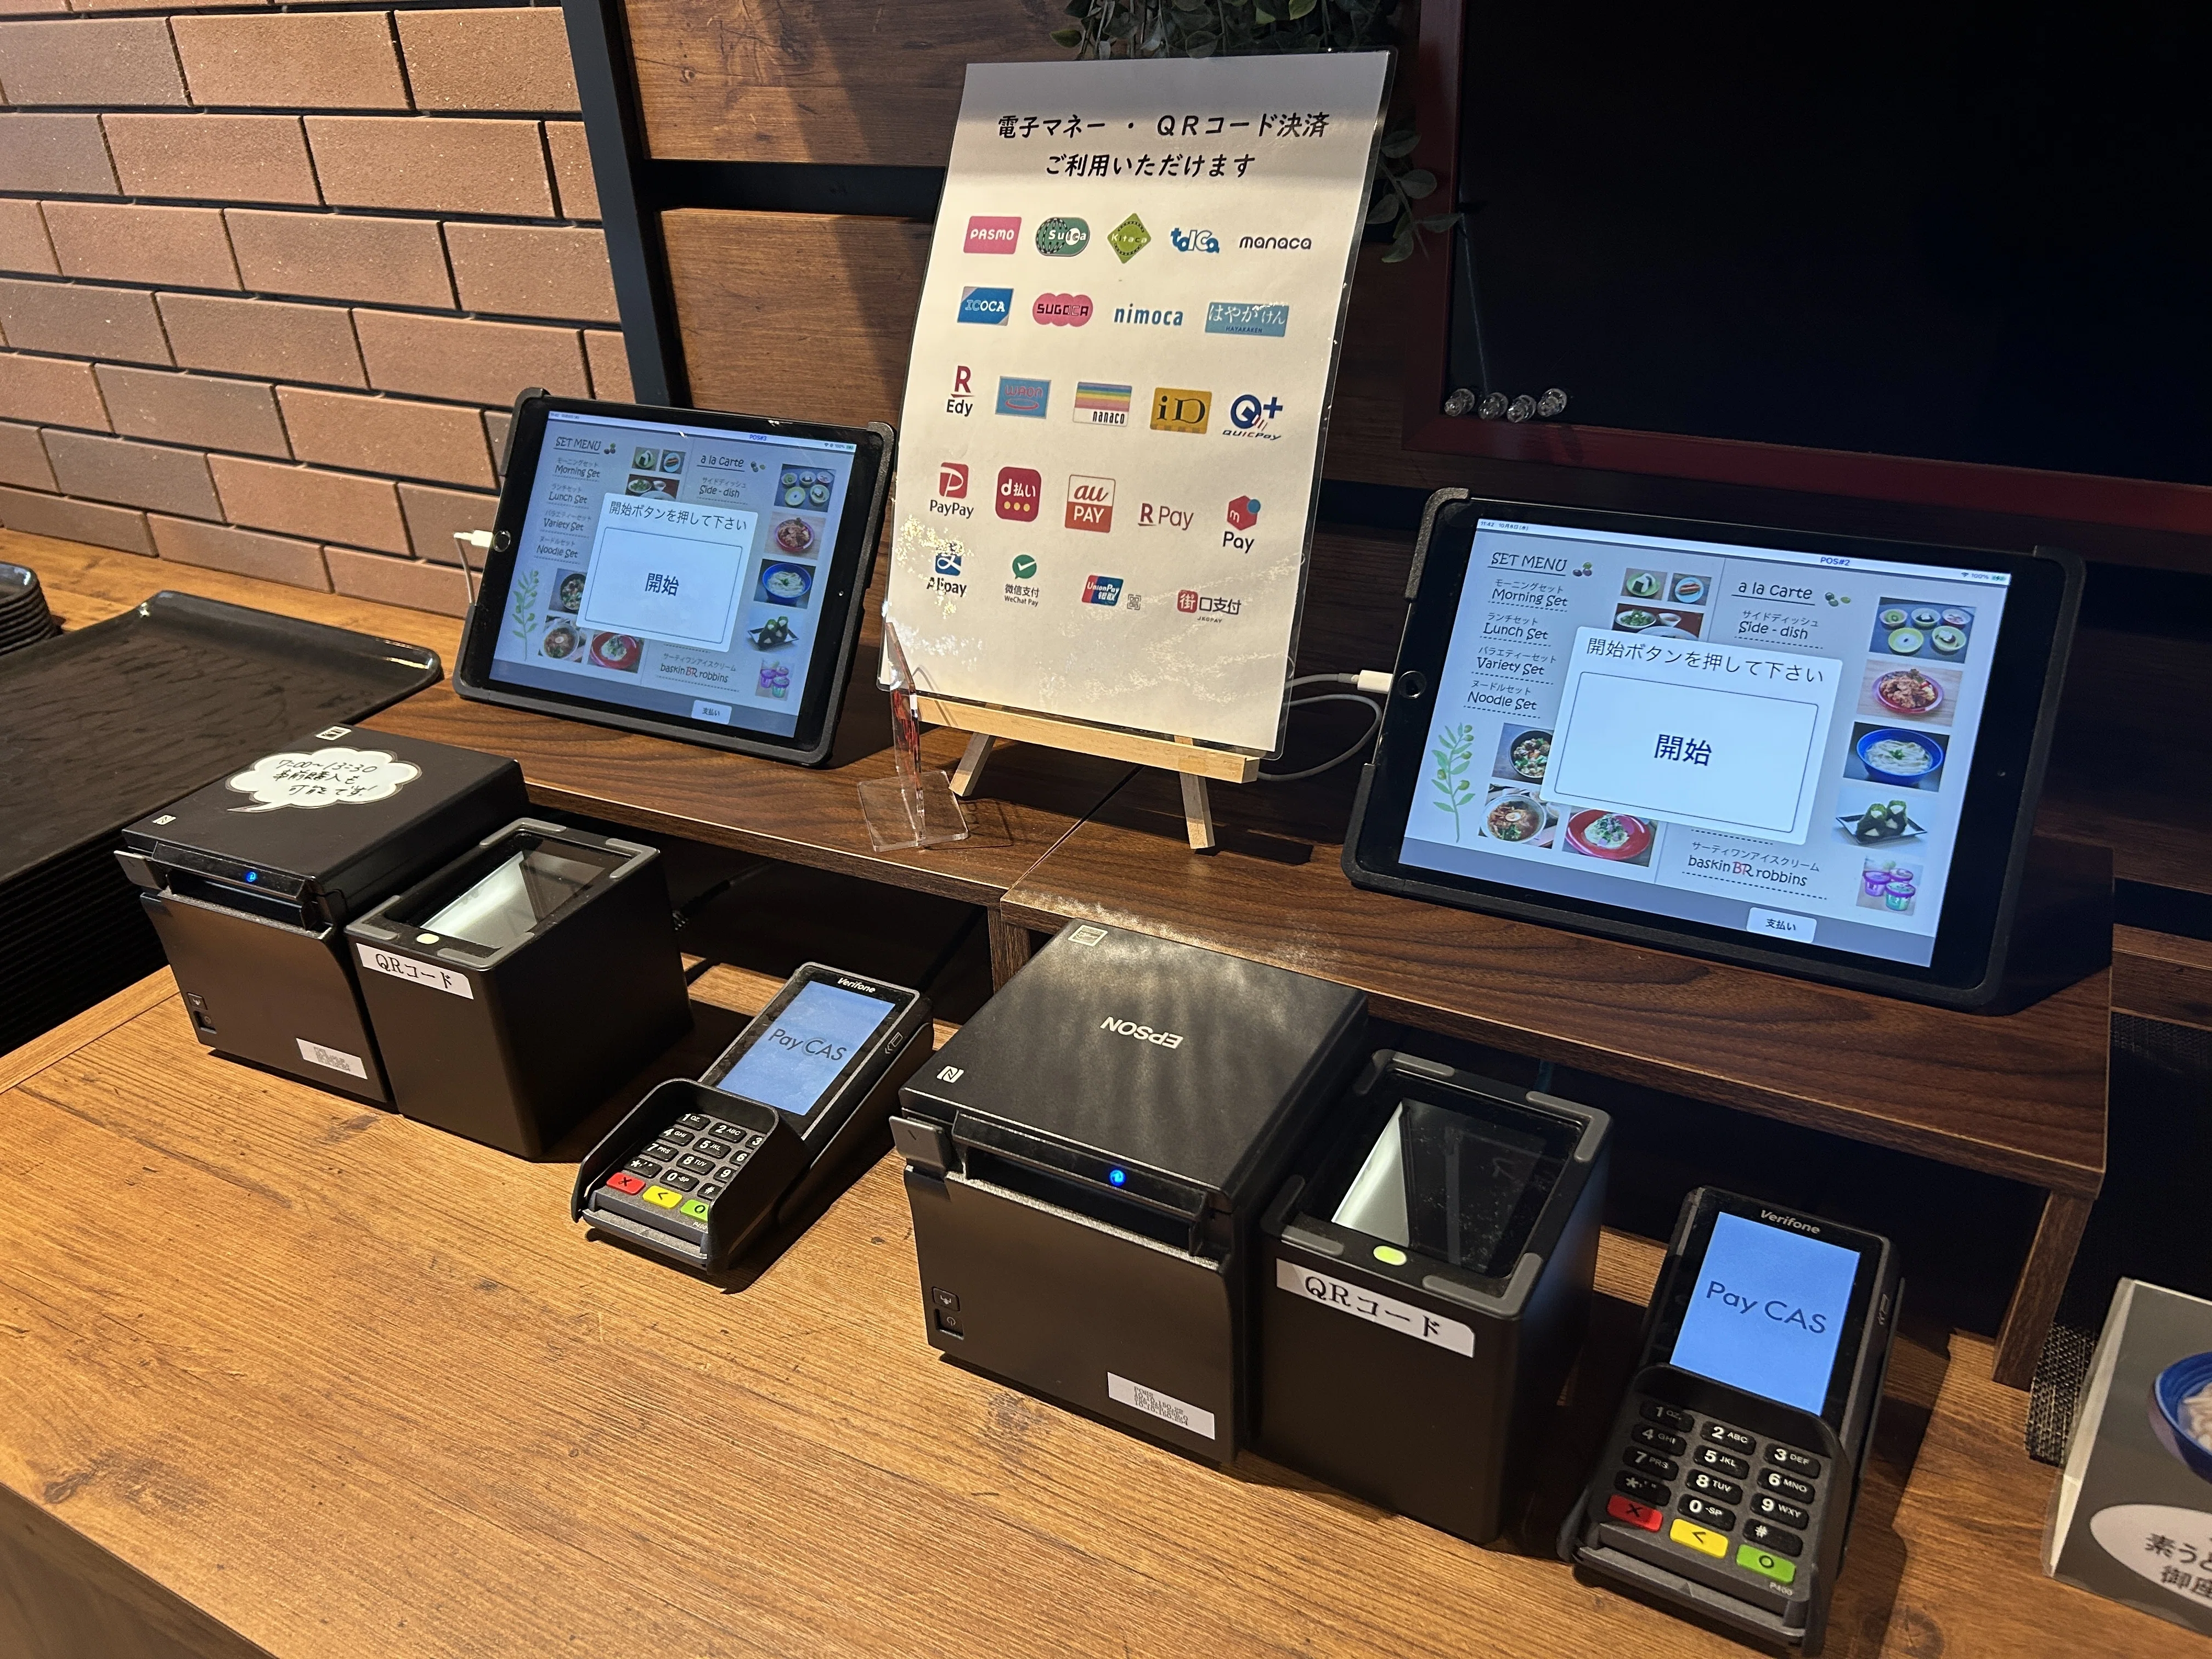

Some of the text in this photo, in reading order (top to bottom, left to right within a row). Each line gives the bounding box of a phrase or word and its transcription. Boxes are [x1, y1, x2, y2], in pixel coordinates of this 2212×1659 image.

[998, 115, 1105, 138] 電子マネー
[1156, 112, 1330, 138] QRコード決済
[1046, 154, 1256, 177] ご利用いただけます
[970, 228, 1014, 241] PASMO
[1048, 228, 1087, 245] Suica
[1111, 233, 1147, 245] Kitaca
[1239, 235, 1312, 251] manaca
[965, 299, 1006, 314] ICOCA
[1037, 303, 1088, 317] SUGOCA
[1114, 306, 1183, 327] nimoca
[946, 399, 973, 417] Edy
[1157, 396, 1206, 424] iD
[1092, 411, 1125, 425] nanaco
[1222, 429, 1282, 441] QUICPay
[556, 437, 601, 451] SET MENU
[701, 455, 706, 464] a
[709, 455, 716, 465] la
[555, 465, 600, 478] Morning Set
[699, 484, 740, 498] Side dish
[1001, 479, 1036, 497] d払い
[1073, 483, 1108, 501] au
[549, 491, 588, 504] Lunch Set
[609, 500, 746, 531] 開始ボタンを押して下さい
[930, 500, 974, 519] PayPay
[1073, 506, 1104, 523] PAY
[544, 518, 584, 532] Variety Set
[1159, 506, 1194, 531] Pay
[537, 544, 578, 558] Noodle Set
[1222, 532, 1254, 554] Pay
[1491, 552, 1567, 572] SET MENU
[1820, 556, 1850, 567] POS#2
[645, 572, 680, 597] 開始
[926, 577, 967, 597] Alipay
[1005, 584, 1040, 599] 微信支付
[1087, 582, 1119, 594] UnionPay
[1495, 579, 1564, 594] モーニングセット
[1738, 582, 1747, 593] a
[1752, 582, 1764, 596] la
[1005, 595, 1039, 607] WeChat Pay
[1492, 588, 1568, 607] Morning Set
[1487, 612, 1538, 625] ランチセット
[1742, 610, 1819, 628] サイドディッシュ
[1482, 622, 1549, 641] Lunch Set
[1739, 620, 1808, 640] Side dish
[1479, 646, 1556, 663] バラエティーセット
[1587, 636, 1823, 683] 開始ボタンを押して下さい
[1477, 657, 1545, 676] Variety Set
[1471, 680, 1532, 695] ヌードルセット
[1467, 691, 1538, 711] Noodle Set
[702, 707, 720, 716] 支払い
[1654, 733, 1713, 766] 開始
[1692, 841, 1820, 872] サーティワンアイスクリーム
[1688, 854, 1730, 873] baskin
[1756, 867, 1808, 887] robbins
[1765, 917, 1797, 932] 支払い
[375, 953, 452, 989] QRコード
[837, 978, 876, 993] Verifone
[1100, 1016, 1183, 1049] EPSON
[768, 1028, 847, 1060] Pay CAS
[681, 1113, 690, 1121] 1
[663, 1128, 674, 1137] 4
[715, 1125, 726, 1133] 2
[647, 1143, 671, 1154] 7 PRS
[699, 1141, 721, 1152] 5 JKL
[752, 1137, 763, 1146] 3
[683, 1156, 694, 1165] 8
[736, 1153, 747, 1161] 6
[667, 1172, 678, 1181] 0
[720, 1169, 731, 1178] 9
[1760, 1209, 1820, 1234] Verifone
[1305, 1276, 1440, 1336] QRコード
[1706, 1280, 1827, 1334] Pay CAS
[1656, 1406, 1663, 1418] 1
[1642, 1429, 1676, 1444] 4 GHI
[1711, 1426, 1748, 1444] 2 ABC
[1635, 1451, 1668, 1469] 7 PRS
[1704, 1450, 1735, 1467] 5 JKL
[1774, 1448, 1810, 1466] 3 DEF
[1696, 1474, 1732, 1493] 8 TUV
[1768, 1472, 1807, 1493] 6 MNO
[1689, 1499, 1702, 1513] 0
[1761, 1498, 1801, 1518] 9 WXY
[1770, 1582, 1793, 1596] P400
